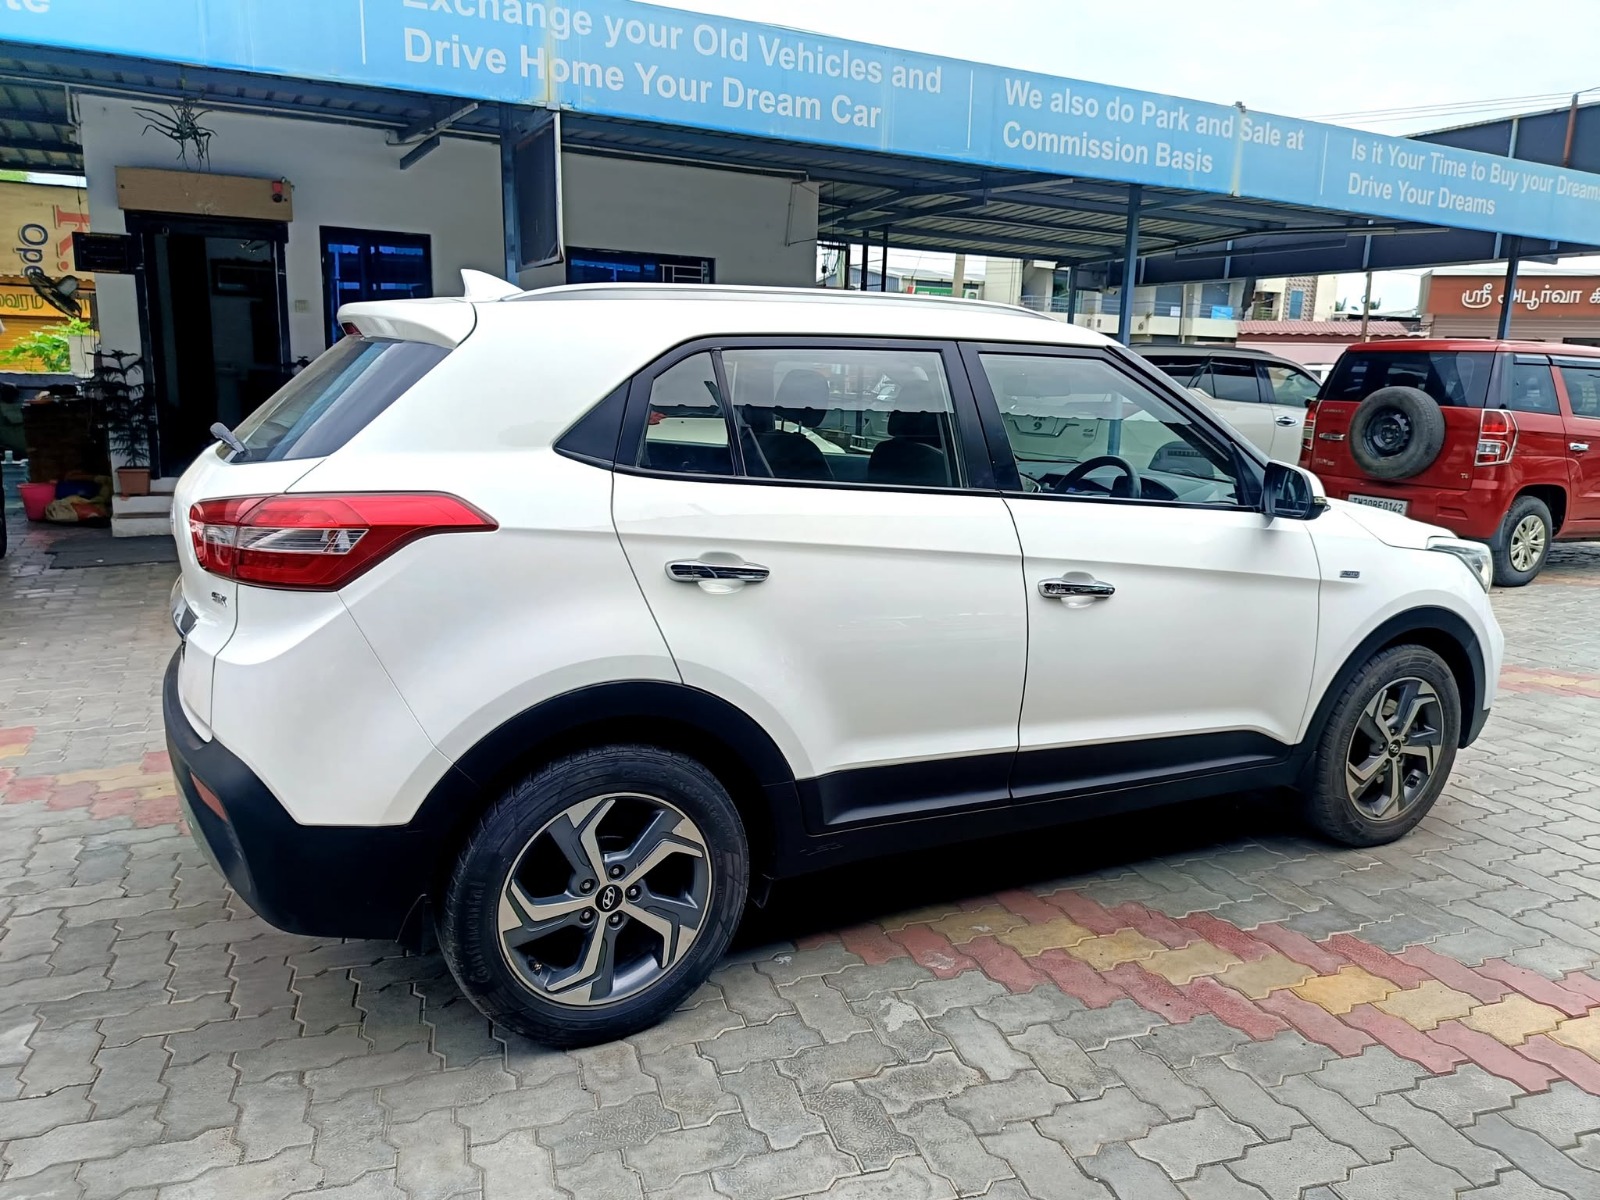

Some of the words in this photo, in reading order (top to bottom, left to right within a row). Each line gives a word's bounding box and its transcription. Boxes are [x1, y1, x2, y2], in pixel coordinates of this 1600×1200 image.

[404, 27, 507, 74] Drive
[520, 44, 624, 91] Home
[633, 62, 713, 104] Your
[723, 77, 821, 121] Dream
[831, 95, 882, 128] Car
[603, 15, 683, 50] your
[693, 24, 748, 62] Old
[758, 35, 883, 84] Vehicles
[892, 66, 942, 94] and
[1004, 78, 1043, 110] We
[1050, 88, 1099, 118] also
[1106, 96, 1134, 123] do
[1141, 101, 1190, 132] Park
[1195, 115, 1233, 139] and
[1239, 117, 1281, 147] Sale
[1286, 129, 1304, 151] at
[1003, 121, 1148, 165] Commission
[1155, 142, 1213, 173] Basis
[1351, 138, 1366, 161] Is
[1372, 142, 1382, 164] it
[1388, 144, 1426, 172] Your
[1430, 151, 1467, 178] Time
[1471, 161, 1486, 181] to
[1490, 163, 1518, 192] Buy
[1522, 173, 1555, 193] your
[1348, 172, 1393, 200] Drive
[1398, 180, 1435, 206] Your
[1438, 187, 1496, 215] Dreams
